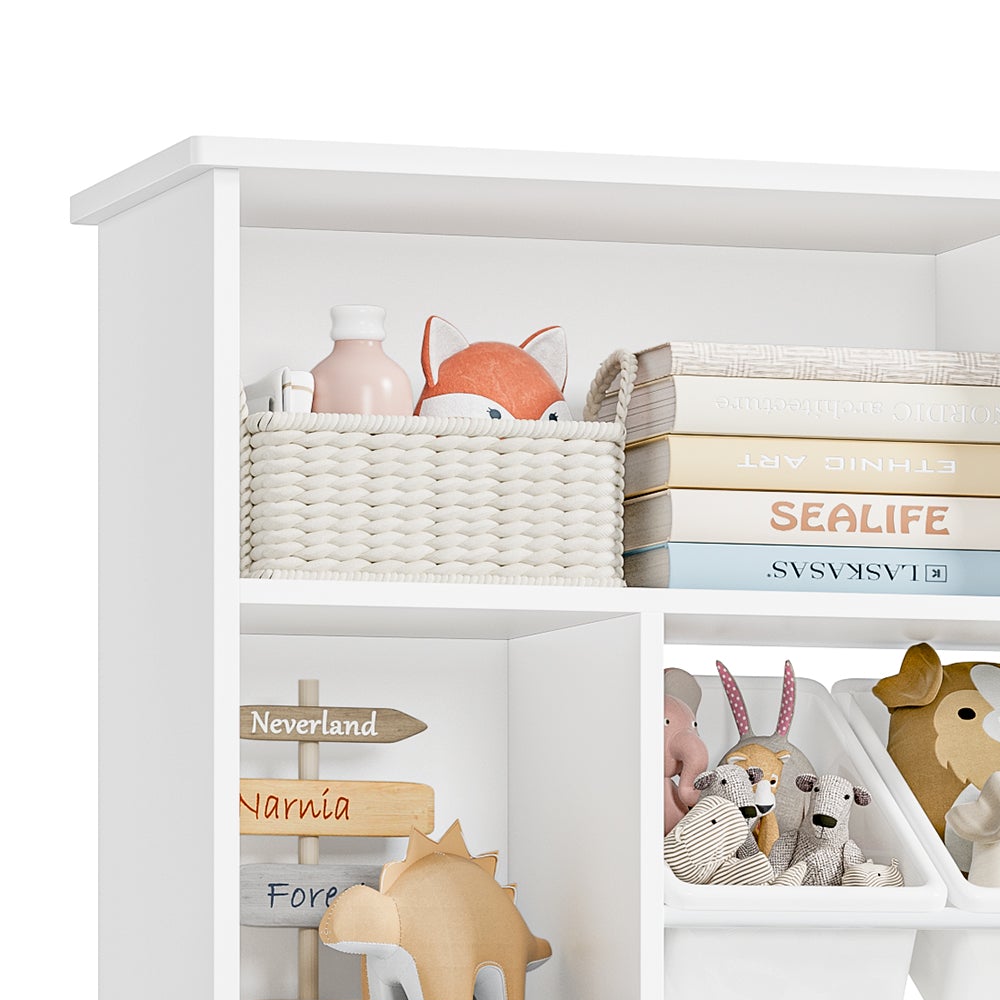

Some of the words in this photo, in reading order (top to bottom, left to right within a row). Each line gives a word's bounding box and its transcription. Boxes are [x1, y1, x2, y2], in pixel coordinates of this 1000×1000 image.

[715, 395, 883, 421] architecture
[736, 453, 807, 470] ART
[825, 456, 956, 474] ETHNIC
[770, 501, 950, 536] SEALIFE
[251, 711, 378, 737] Neverland
[239, 788, 349, 820] Narnia
[267, 882, 364, 908] Fore
